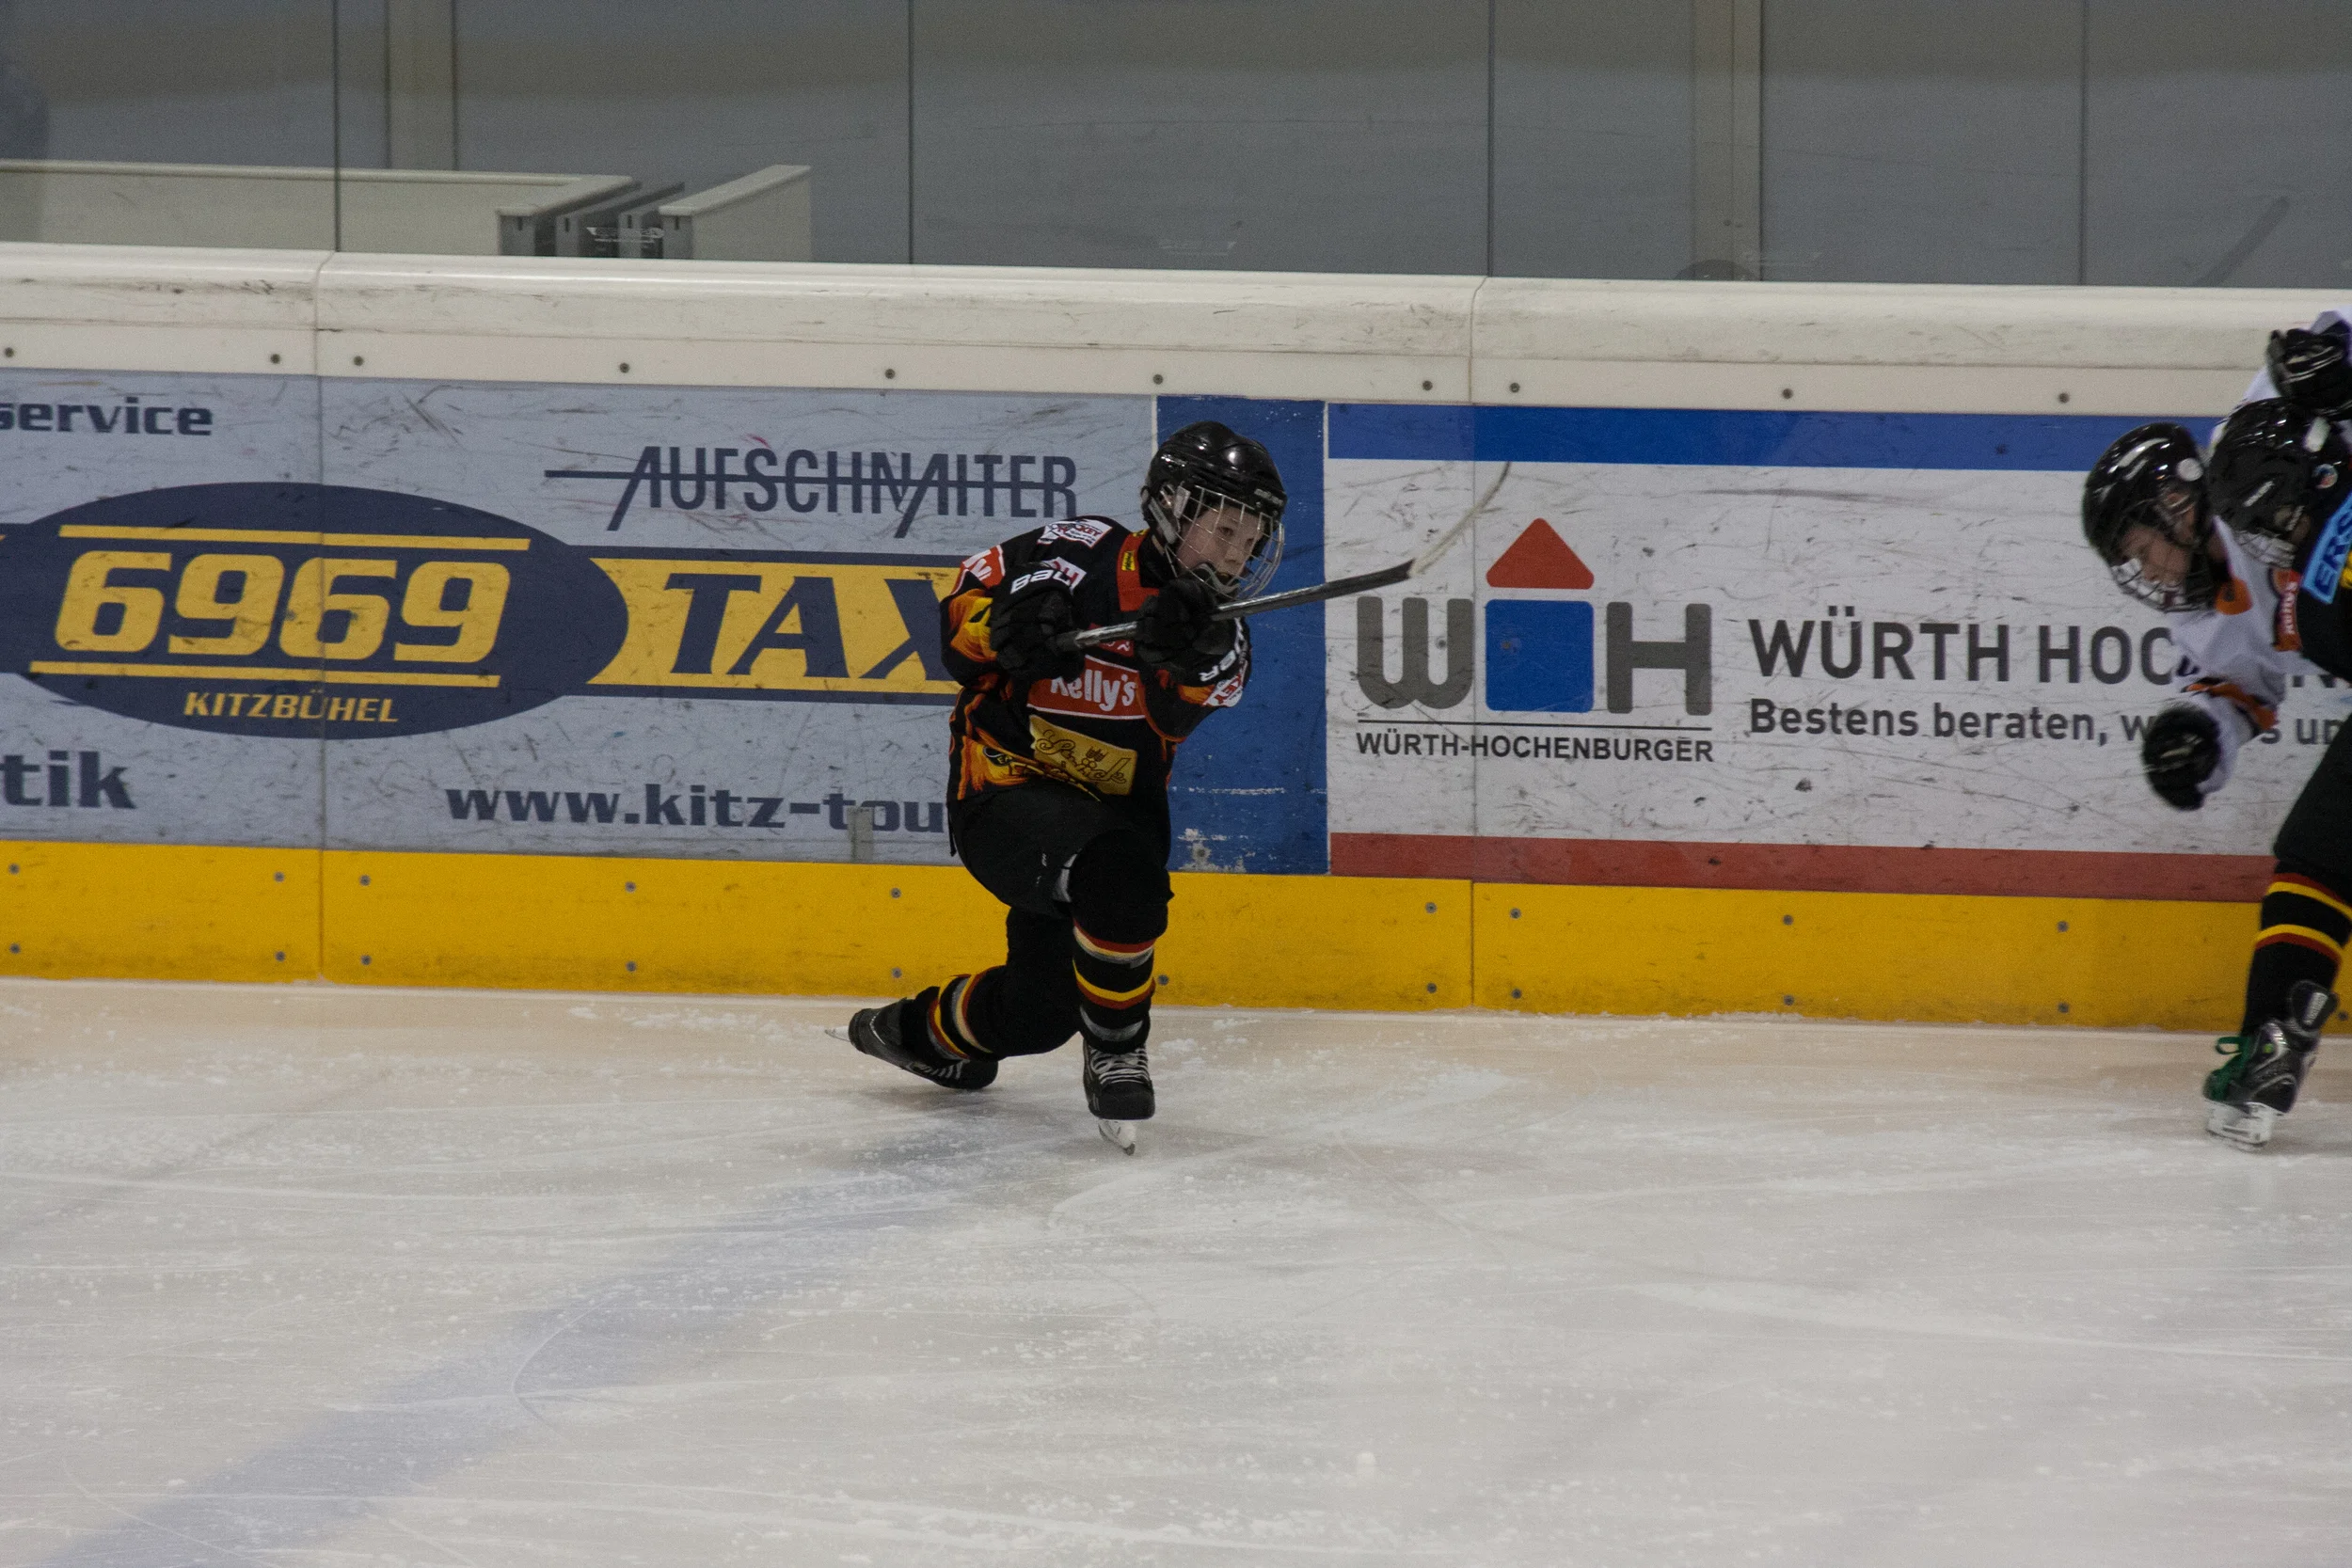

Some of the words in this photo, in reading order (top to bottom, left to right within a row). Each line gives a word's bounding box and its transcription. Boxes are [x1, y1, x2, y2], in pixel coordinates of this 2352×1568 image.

[607, 445, 1077, 539] AUFSCHNAITER
[55, 550, 511, 663] 6969
[1747, 605, 2010, 683] WÜRTH
[183, 689, 399, 723] KITZBÜHEL
[1750, 699, 1918, 737] Bestens
[1933, 703, 2108, 746] beraten,
[1356, 728, 1714, 762] WÜRTH-HOCHENBURGER
